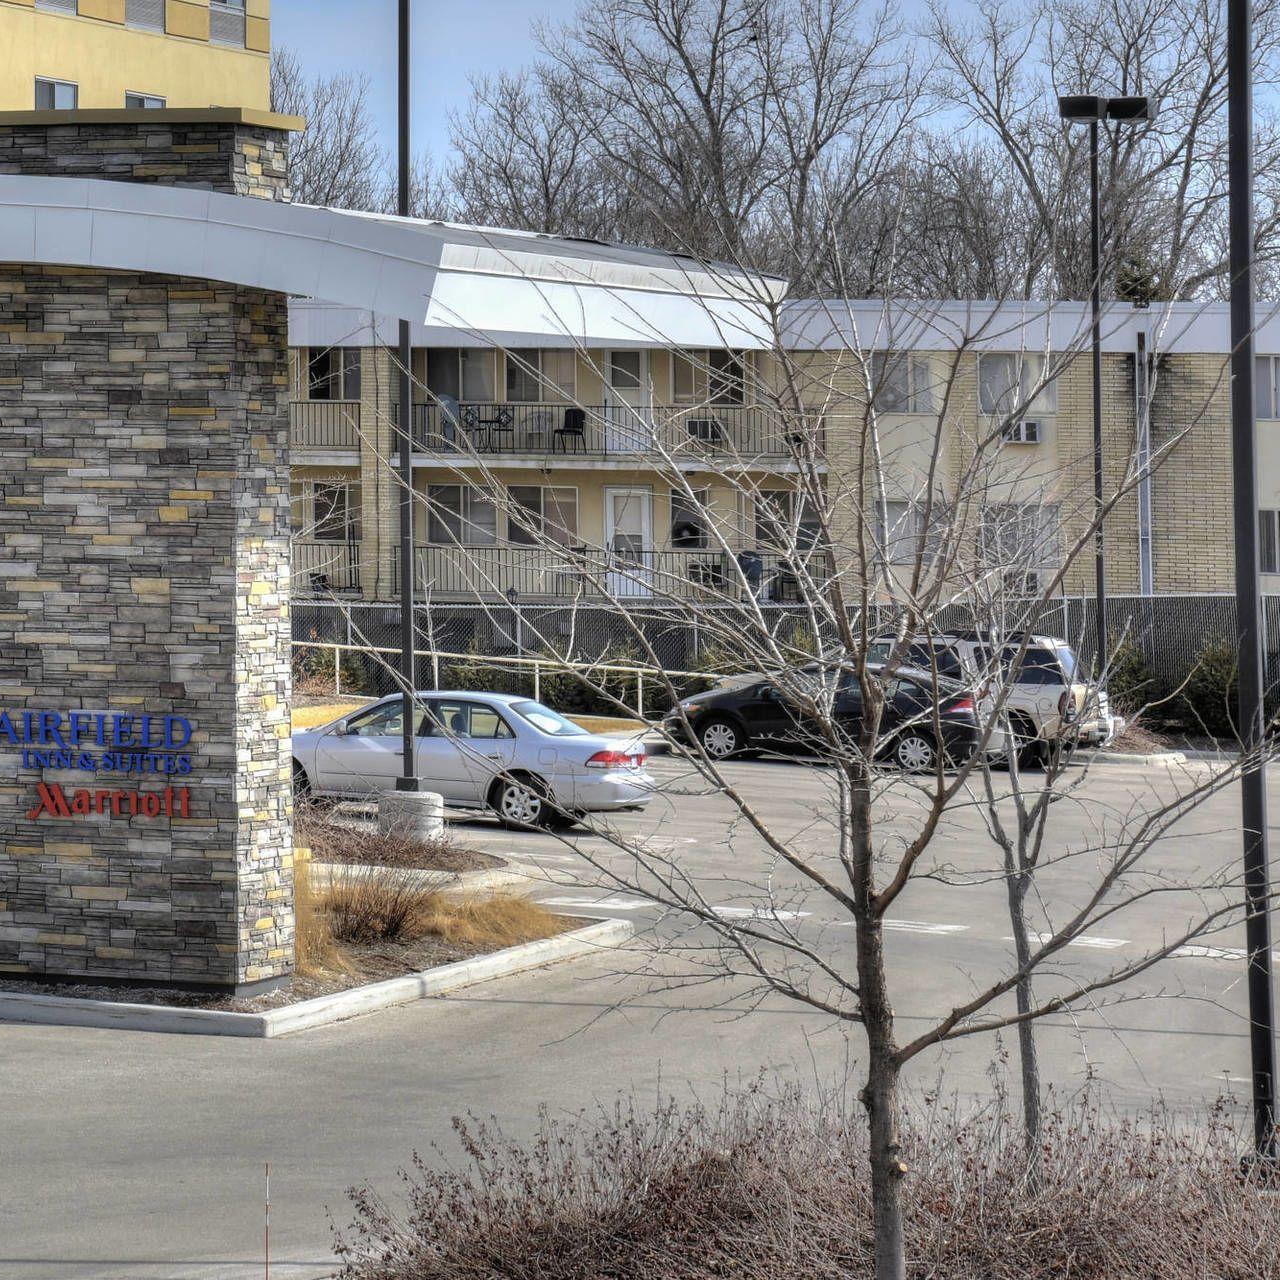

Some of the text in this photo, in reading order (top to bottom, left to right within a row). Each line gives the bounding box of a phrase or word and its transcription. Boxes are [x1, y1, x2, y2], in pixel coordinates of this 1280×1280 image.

[22, 749, 192, 775] INN & SUITES
[26, 781, 191, 821] Marriott
